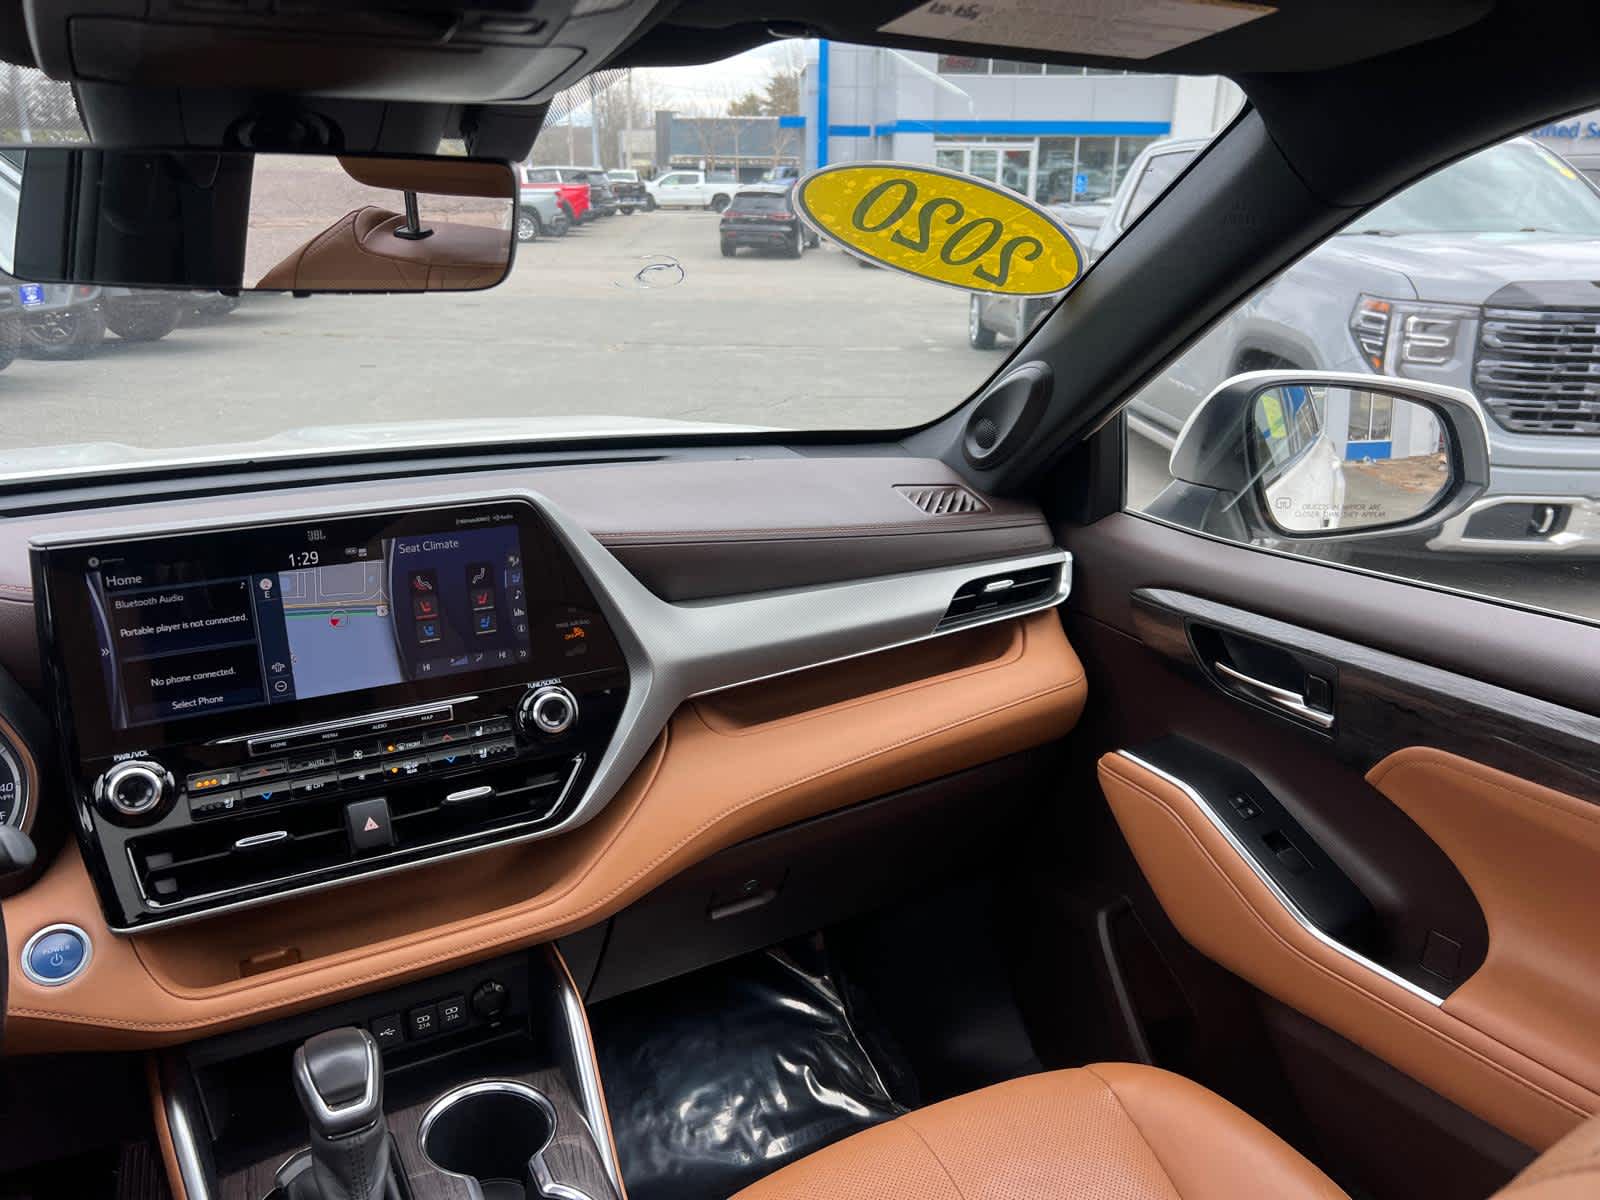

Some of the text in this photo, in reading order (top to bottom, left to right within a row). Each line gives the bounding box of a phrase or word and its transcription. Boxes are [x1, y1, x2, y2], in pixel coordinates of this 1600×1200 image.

[399, 540, 459, 554] Seat Climate
[288, 551, 320, 568] 1:29
[105, 575, 143, 587] Home
[114, 594, 185, 609] Bluetooth Audio
[120, 626, 155, 638] Portable
[156, 622, 181, 634] player
[190, 619, 205, 628] not
[205, 613, 249, 626] connected.
[151, 666, 237, 687] No phone connected.
[171, 696, 224, 710] Select Phone
